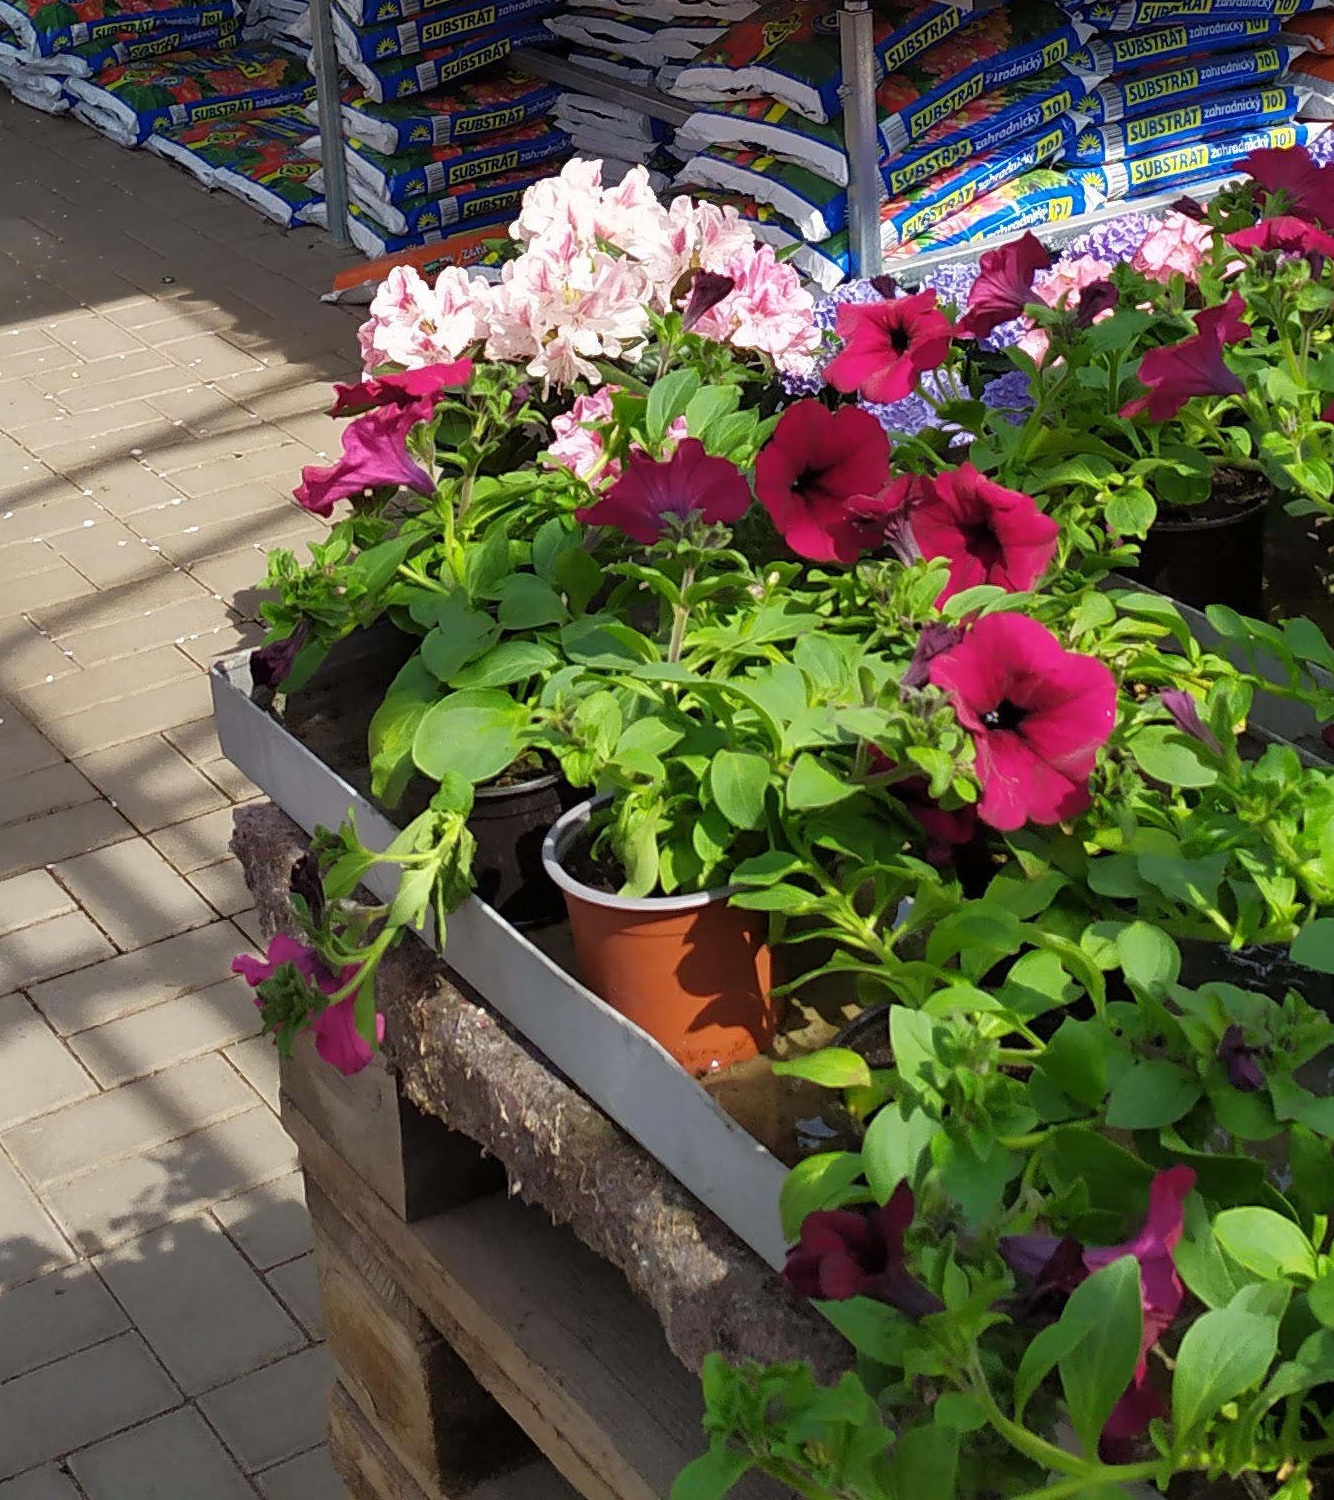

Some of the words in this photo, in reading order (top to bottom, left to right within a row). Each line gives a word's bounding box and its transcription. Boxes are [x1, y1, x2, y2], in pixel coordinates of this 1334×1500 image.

[1189, 19, 1245, 40] zahradnický
[1200, 57, 1255, 80] zahradnický
[1203, 97, 1261, 119] zahradnický
[975, 108, 1042, 150] zahradnický
[1210, 133, 1269, 160] zahradnický
[465, 192, 523, 218] SUBSTRÁ
